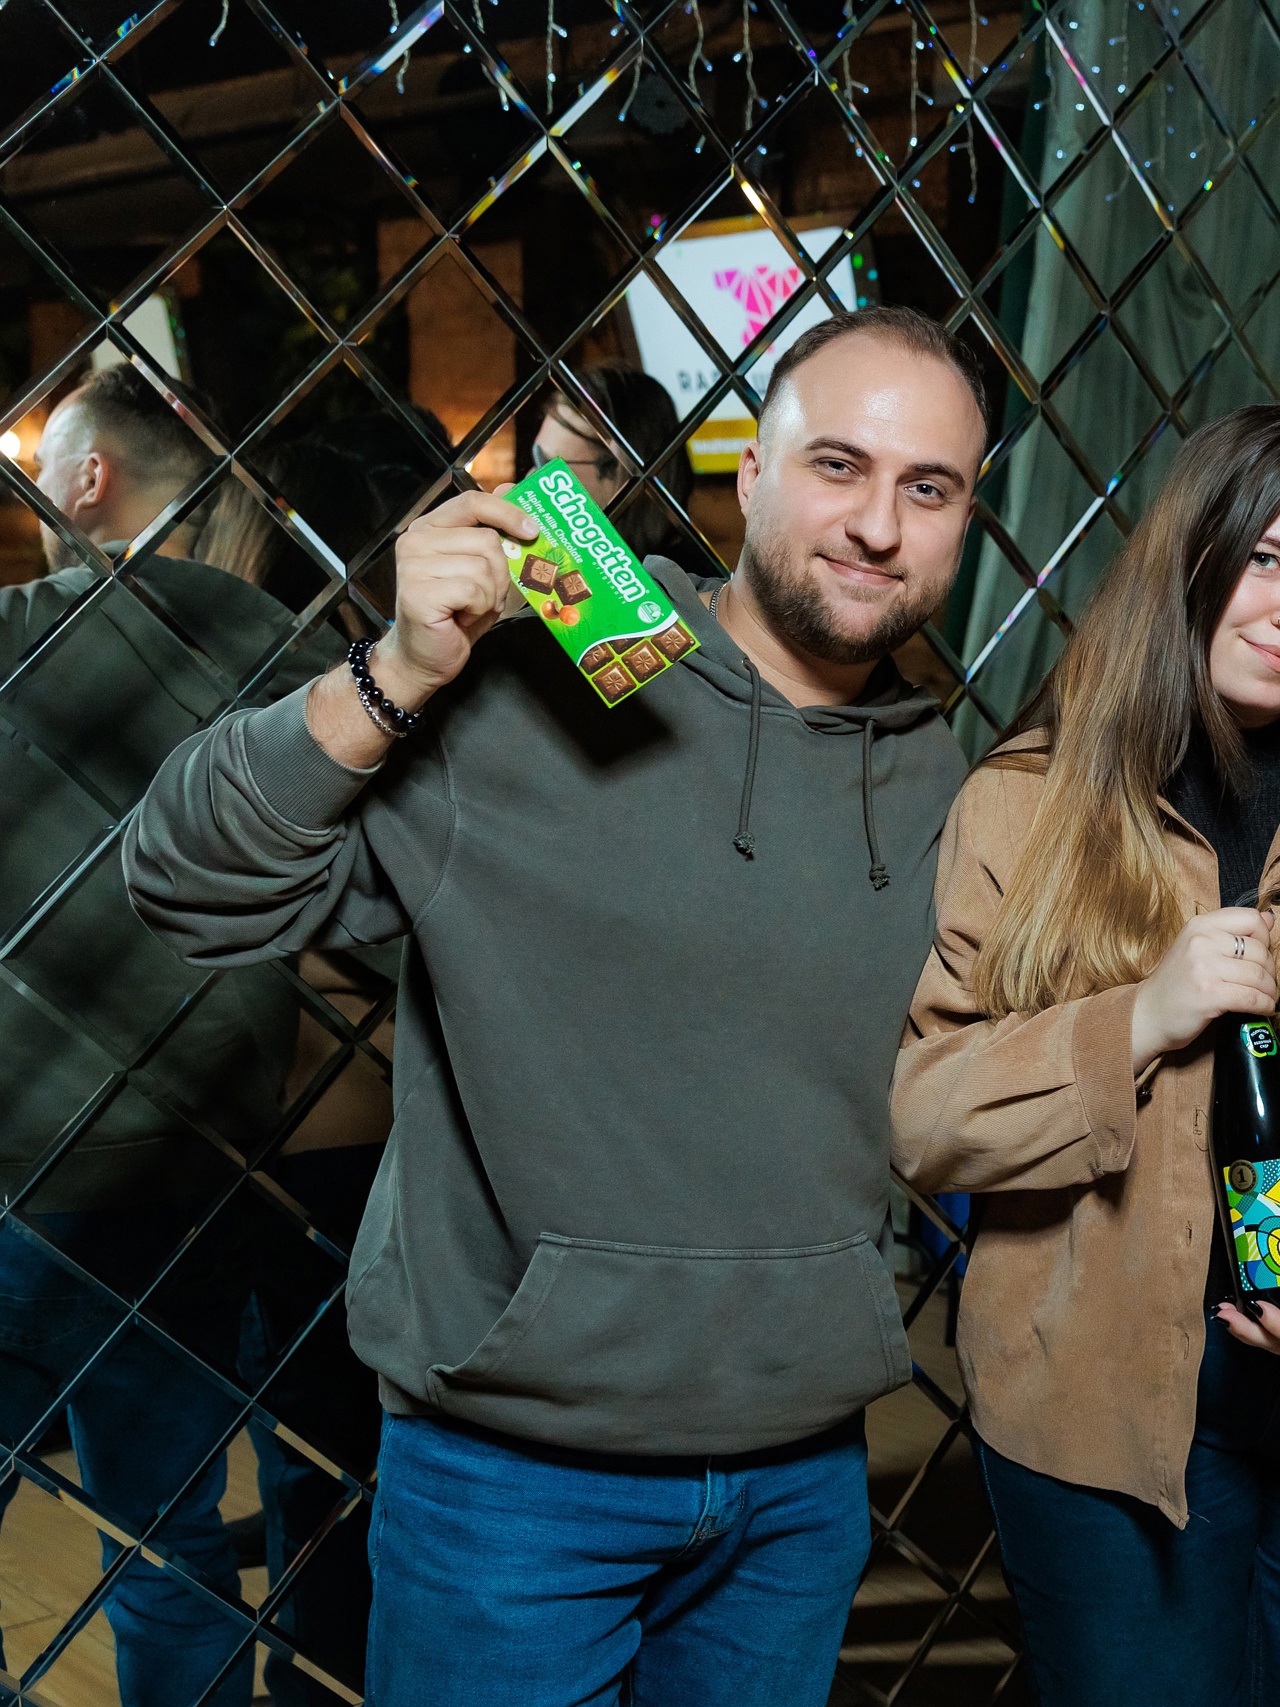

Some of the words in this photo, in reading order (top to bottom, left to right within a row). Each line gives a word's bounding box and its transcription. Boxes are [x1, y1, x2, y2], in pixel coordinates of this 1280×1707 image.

[517, 495, 532, 513] with
[524, 490, 545, 513] Alpine
[542, 512, 558, 529] Milk
[554, 529, 583, 564] Chocolate
[538, 470, 646, 602] Schogetten
[1237, 1168, 1247, 1184] 1
